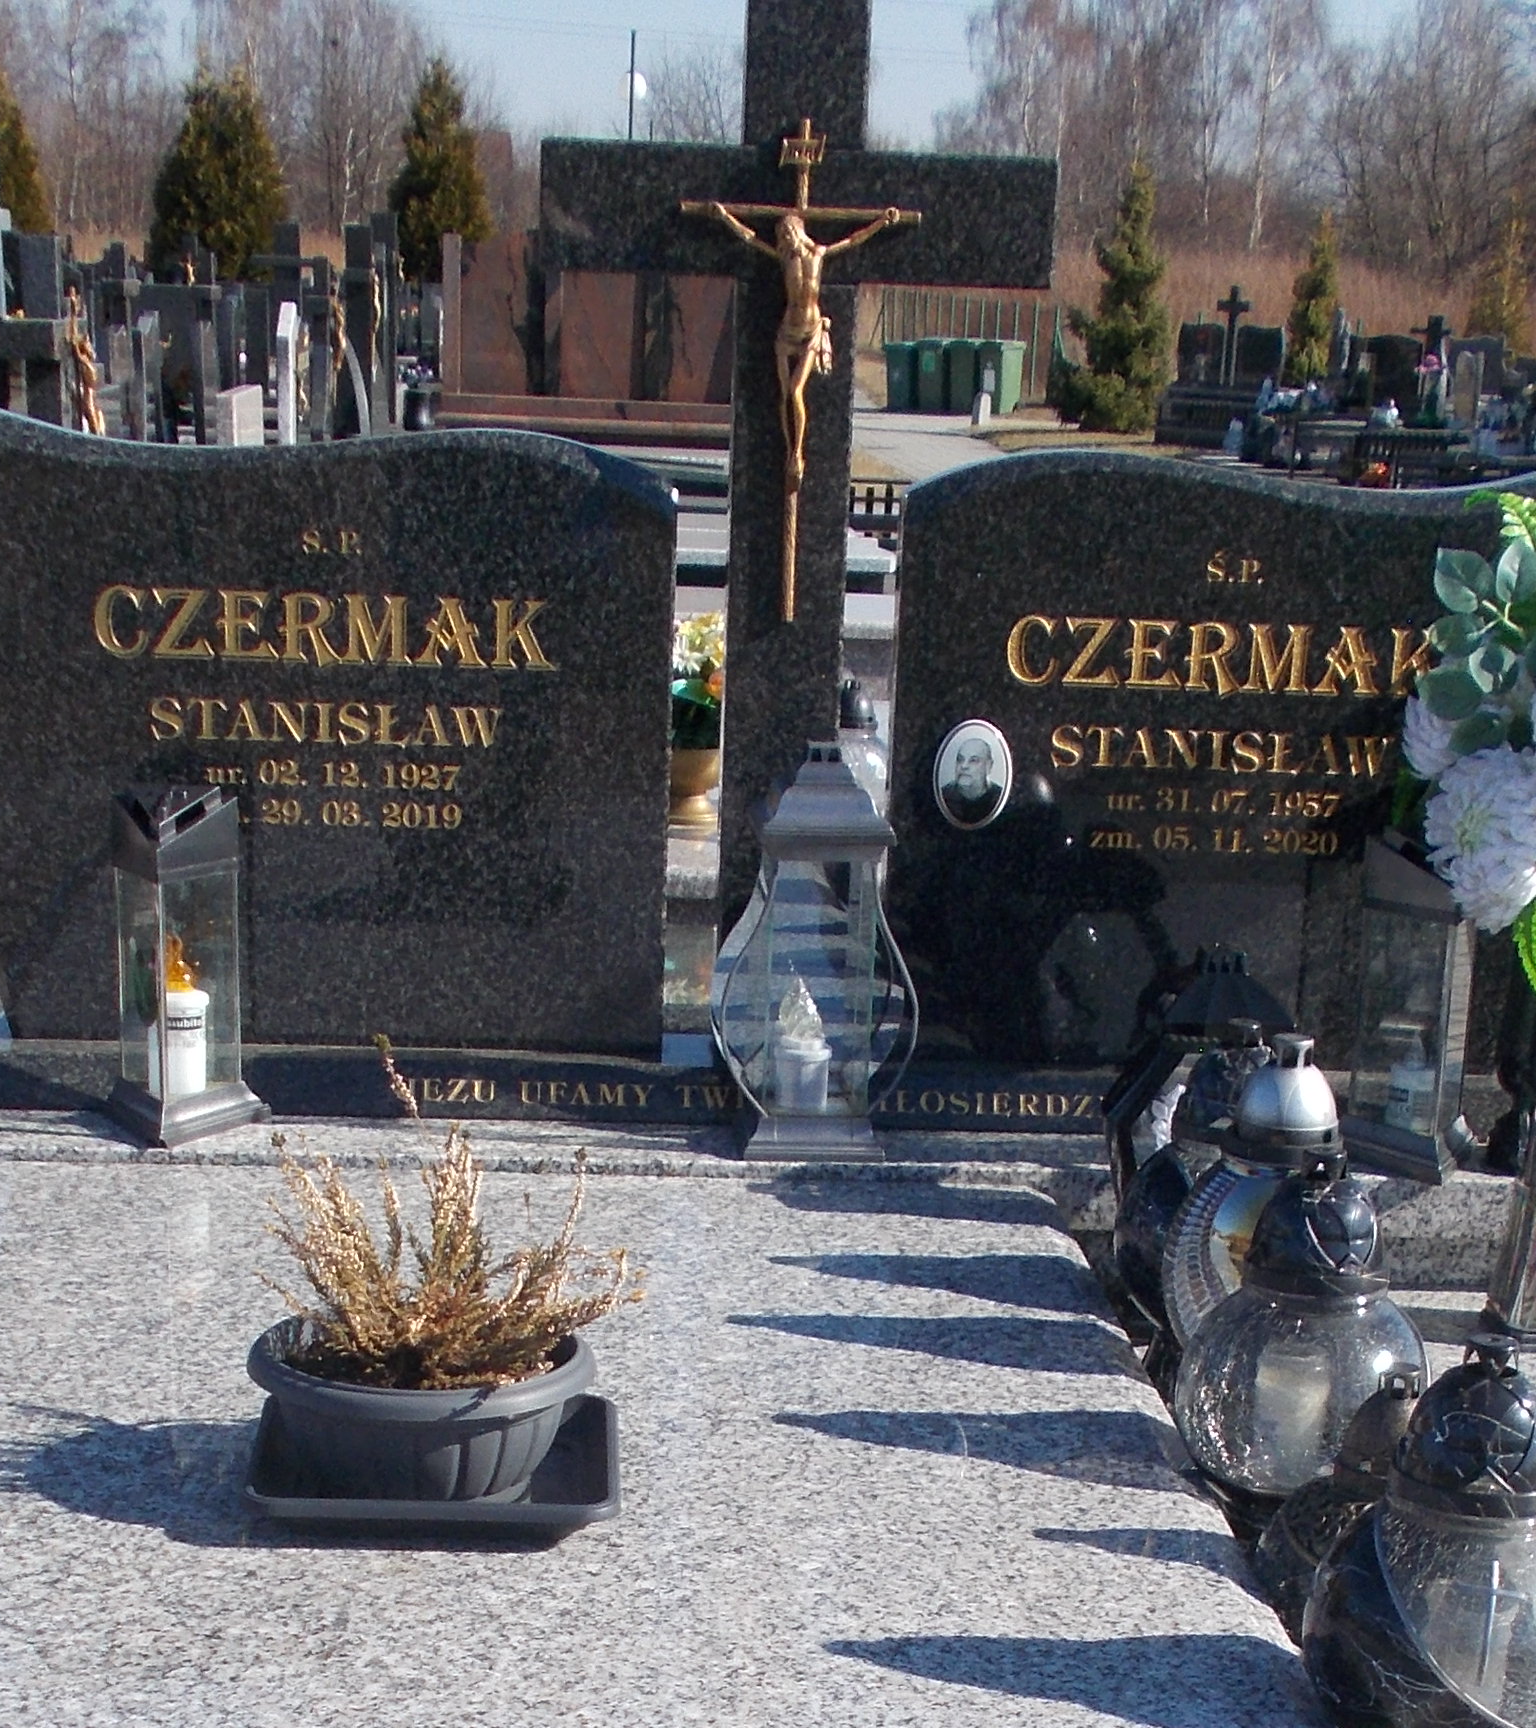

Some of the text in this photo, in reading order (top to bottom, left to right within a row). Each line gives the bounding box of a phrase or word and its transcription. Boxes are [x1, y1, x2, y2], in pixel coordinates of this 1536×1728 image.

[93, 584, 558, 671] CZERMAK
[1007, 614, 1432, 699] CZERMAK
[150, 697, 504, 748] STANISŁAW
[1051, 724, 1396, 780] STANISŁAW
[204, 759, 462, 791] ur. 02. 12. 1927
[262, 799, 310, 826] 29.
[323, 800, 369, 827] 03.
[382, 802, 462, 830] 2019
[1107, 787, 1340, 818] ur. 31. 07. 1957
[1089, 826, 1338, 856] zm. 05. 11. 2020
[521, 1080, 654, 1108] UFAMY
